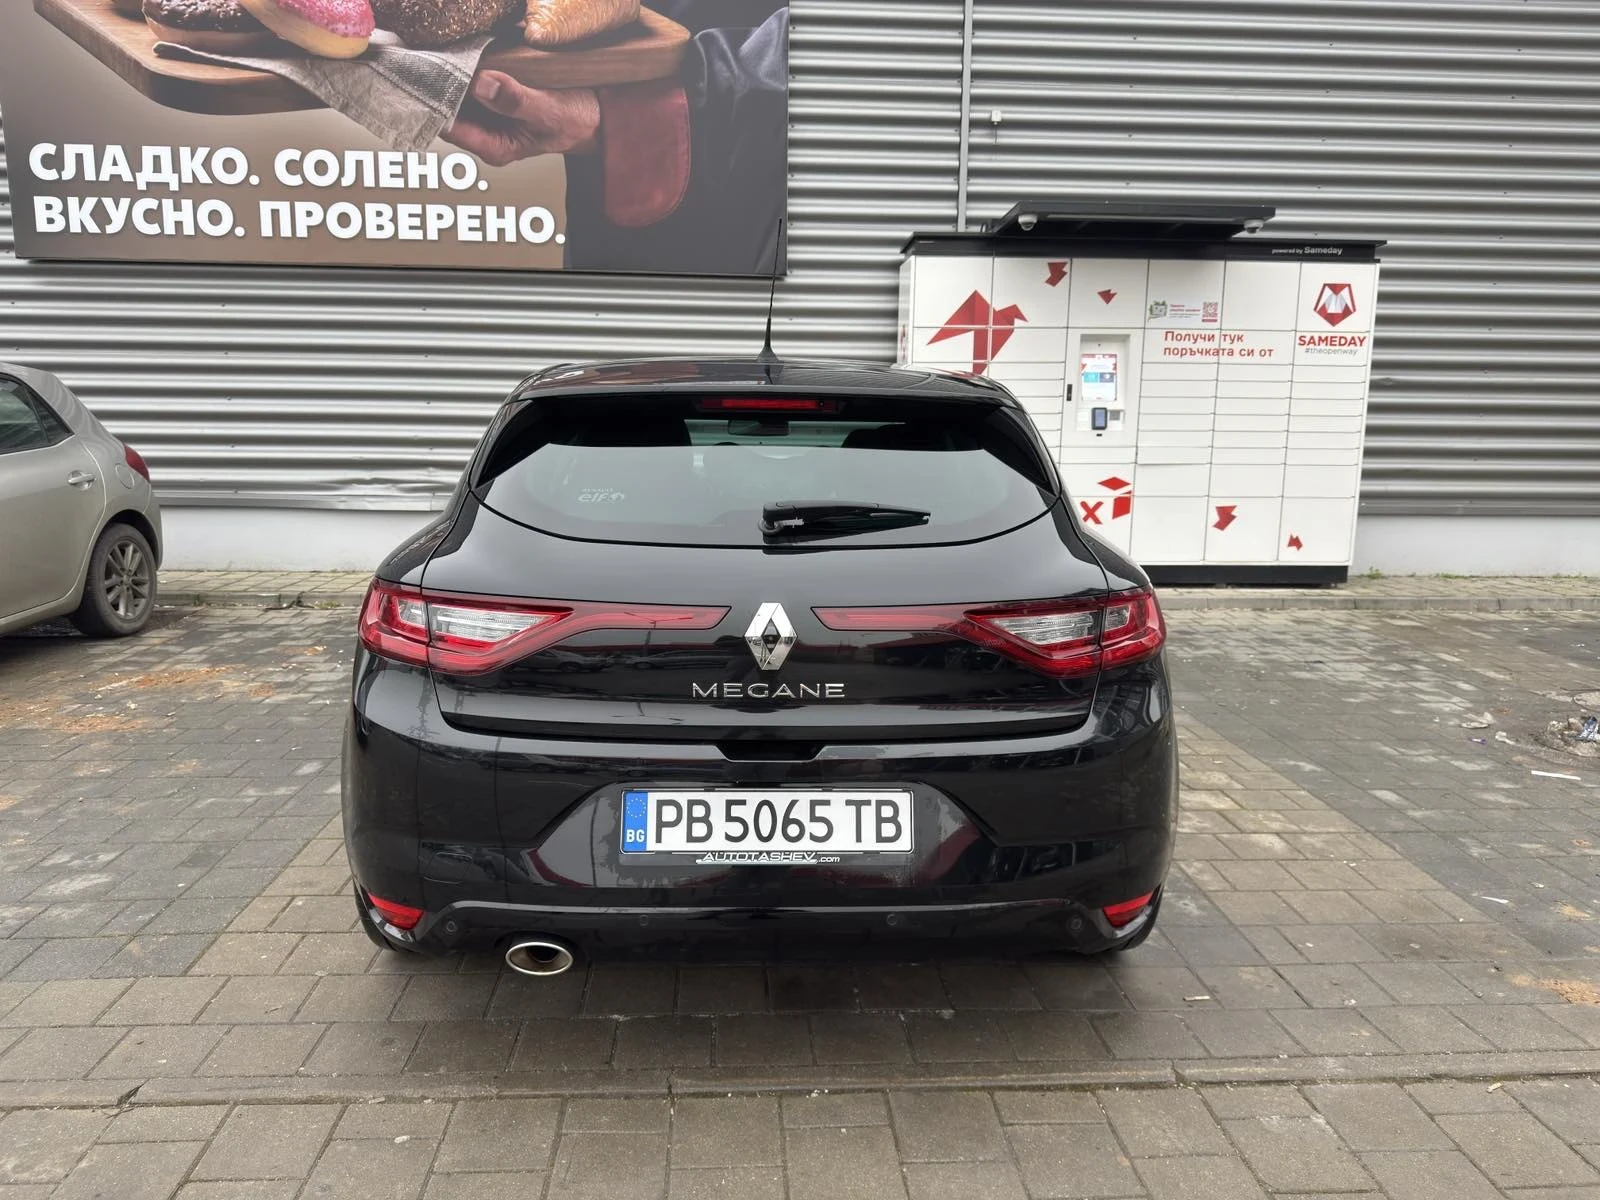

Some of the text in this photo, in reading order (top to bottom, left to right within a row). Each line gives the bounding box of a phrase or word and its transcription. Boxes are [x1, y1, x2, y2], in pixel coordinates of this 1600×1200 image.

[29, 143, 488, 191] СЛАДКО. СОЛЕНО.
[33, 196, 566, 244] ВКУСНО. ПРОВЕРЕНО.
[1304, 246, 1344, 256] Sameday
[1164, 331, 1245, 344] Получи тук
[1298, 335, 1367, 347] SAMEDAY
[1163, 346, 1275, 358] поръчката си от
[692, 682, 845, 698] MEGANE
[655, 799, 902, 843] PB 5065 TB
[626, 829, 645, 843] BG
